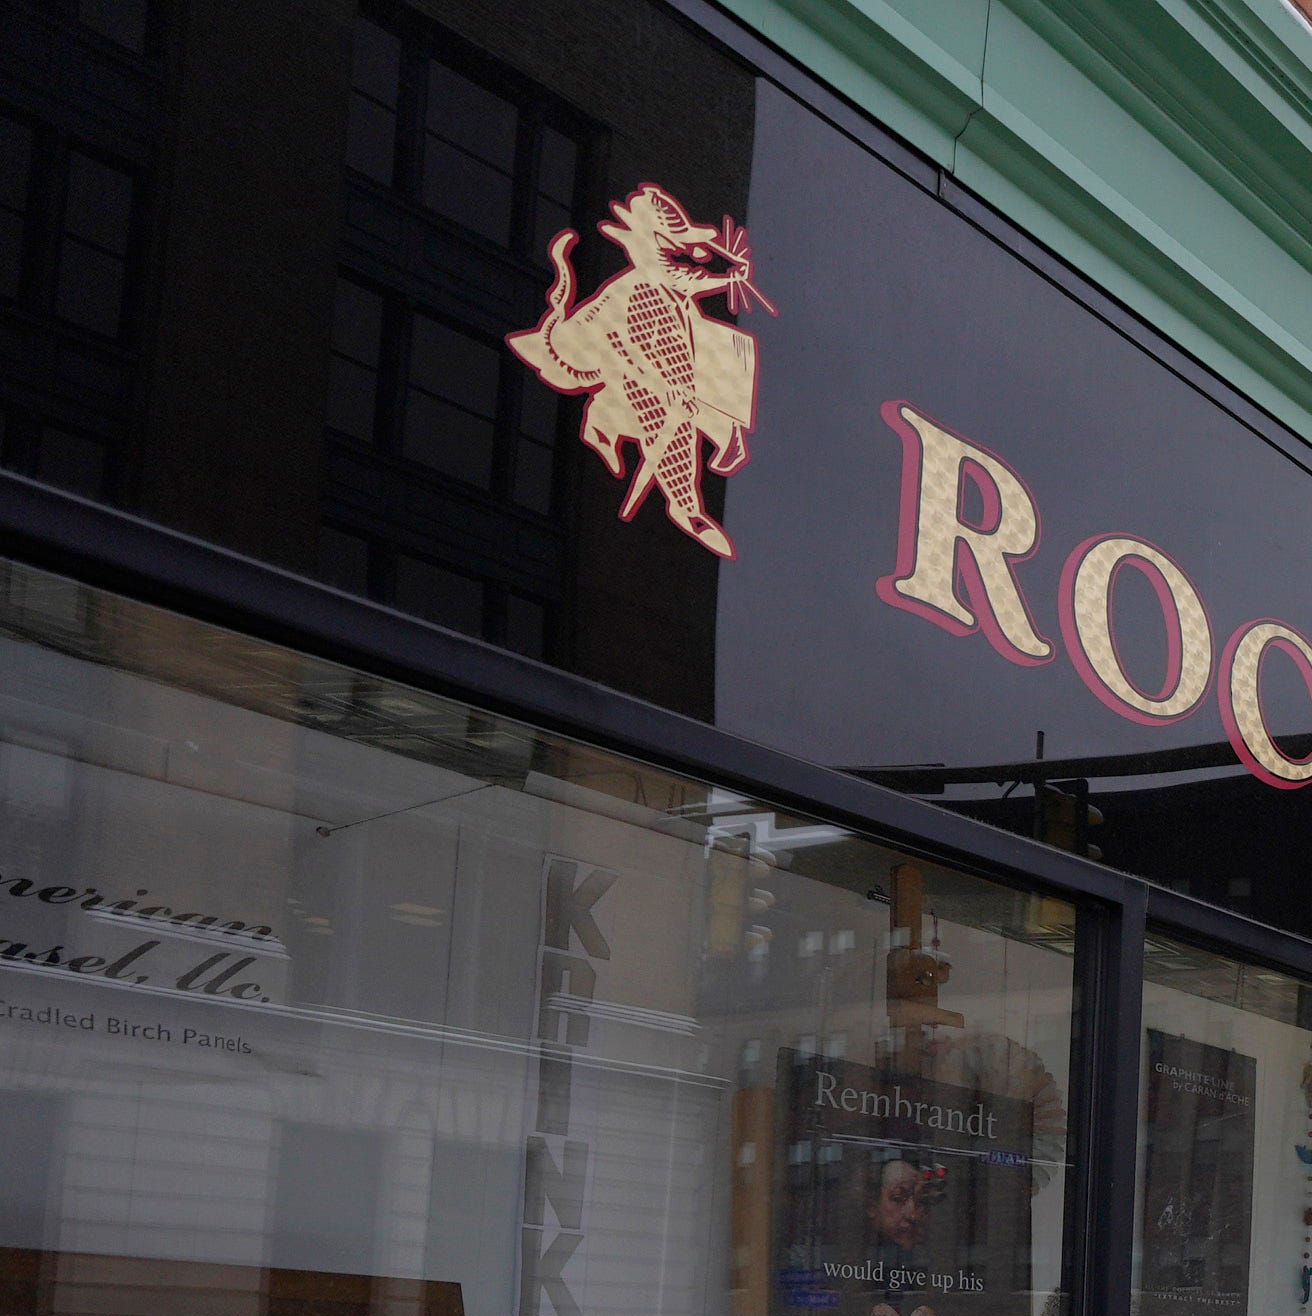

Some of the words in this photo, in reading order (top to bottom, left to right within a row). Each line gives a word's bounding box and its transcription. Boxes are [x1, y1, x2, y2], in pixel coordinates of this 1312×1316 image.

[176, 951, 269, 1003] llc.
[107, 1017, 171, 1042] Birch
[183, 1027, 252, 1055] Panels
[1155, 1063, 1210, 1085] GRAPHITE
[1173, 1080, 1182, 1092] by
[1185, 1083, 1216, 1098] CARAN
[814, 1070, 998, 1139] Rembrandt
[824, 1262, 885, 1282] would
[889, 1265, 926, 1291] give
[931, 1275, 954, 1293] up
[959, 1273, 984, 1292] his
